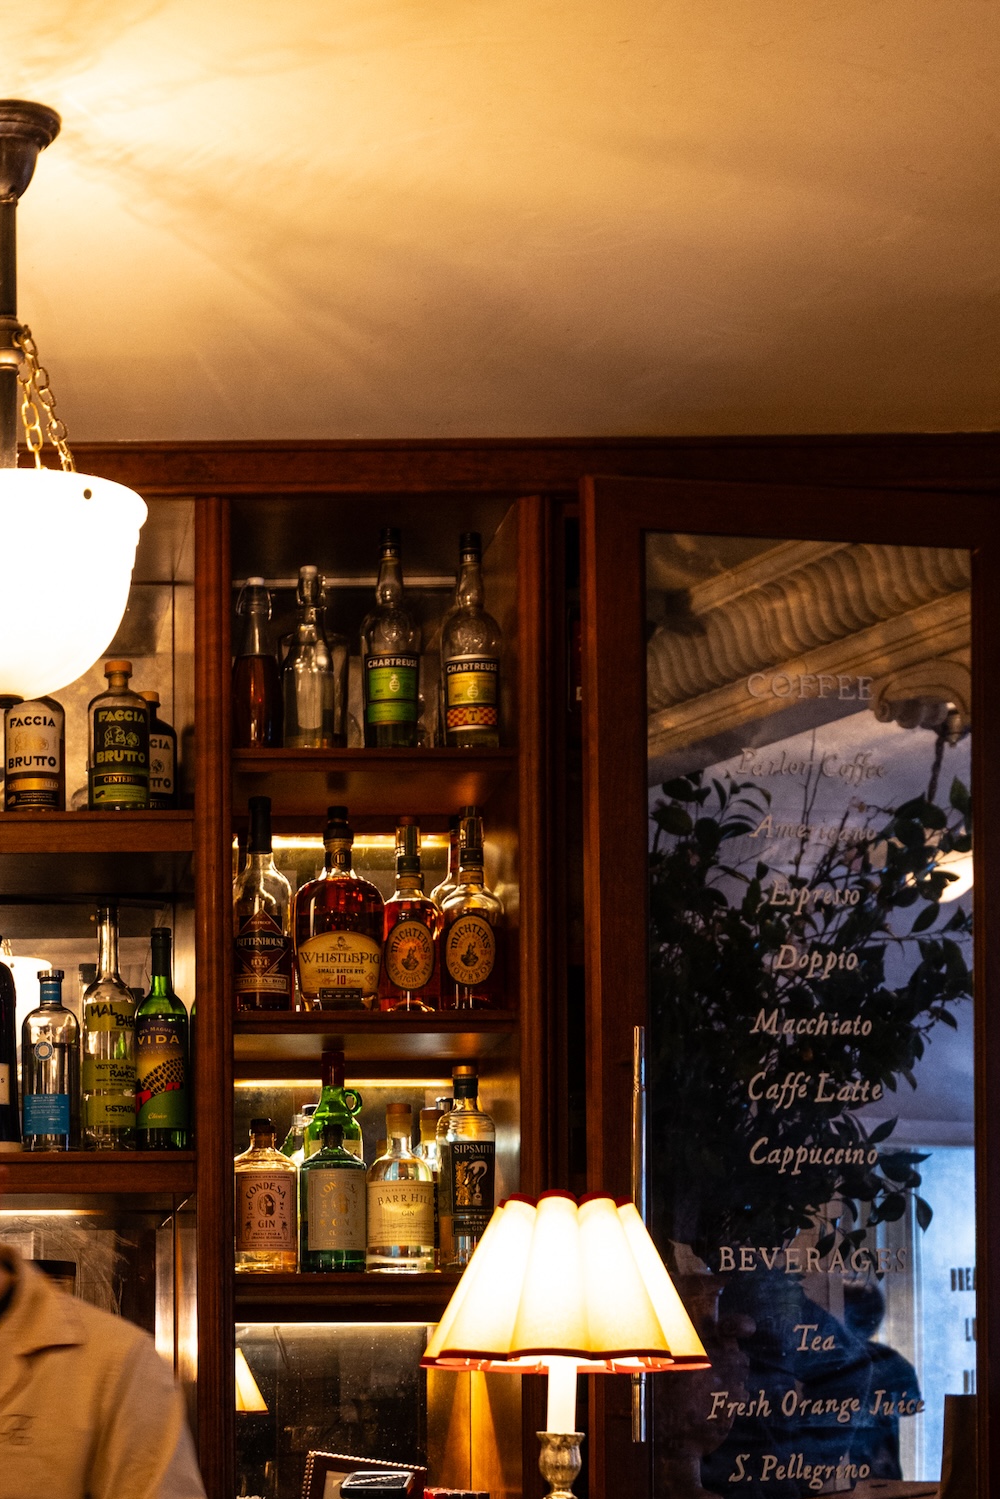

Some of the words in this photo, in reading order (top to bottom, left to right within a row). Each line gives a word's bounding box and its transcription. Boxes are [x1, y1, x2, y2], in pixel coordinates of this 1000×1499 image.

[367, 657, 418, 668] CHARTREUSE
[446, 662, 498, 673] CHARTREUSE
[746, 673, 875, 701] COFFEE
[10, 716, 56, 728] FACCIA
[98, 709, 145, 723] FACCIA
[8, 756, 56, 769] BRUTTO
[96, 750, 146, 763] BRUTTO
[819, 751, 885, 787] Coffee
[749, 815, 877, 843] Americano
[336, 854, 346, 864] 10
[769, 880, 861, 916] Espresso
[236, 937, 285, 948] RITTENHOUSE
[390, 928, 430, 953] MICHTER'S
[451, 923, 491, 949] MICHTER'S
[251, 958, 271, 966] RYE
[450, 959, 492, 979] BOURBON
[774, 944, 859, 980] Doppio
[337, 974, 346, 985] 10
[90, 1004, 117, 1017] MAL
[750, 1008, 873, 1037] Macchiato
[137, 1034, 180, 1046] VIDA
[109, 1070, 135, 1078] RAMOS
[814, 1072, 883, 1103] Latte
[749, 1136, 878, 1176] Cappuccino
[246, 1181, 287, 1199] CONDESA
[377, 1194, 407, 1206] BARR
[411, 1193, 432, 1206] HILL
[257, 1219, 276, 1228] GIN
[718, 1247, 907, 1274] BEVERAGES
[793, 1324, 836, 1353] Tea
[706, 1392, 772, 1420] Fresh
[780, 1391, 861, 1424] Orange
[867, 1389, 925, 1417] Juice
[728, 1453, 754, 1483] S.
[760, 1453, 871, 1490] Pellegrino
